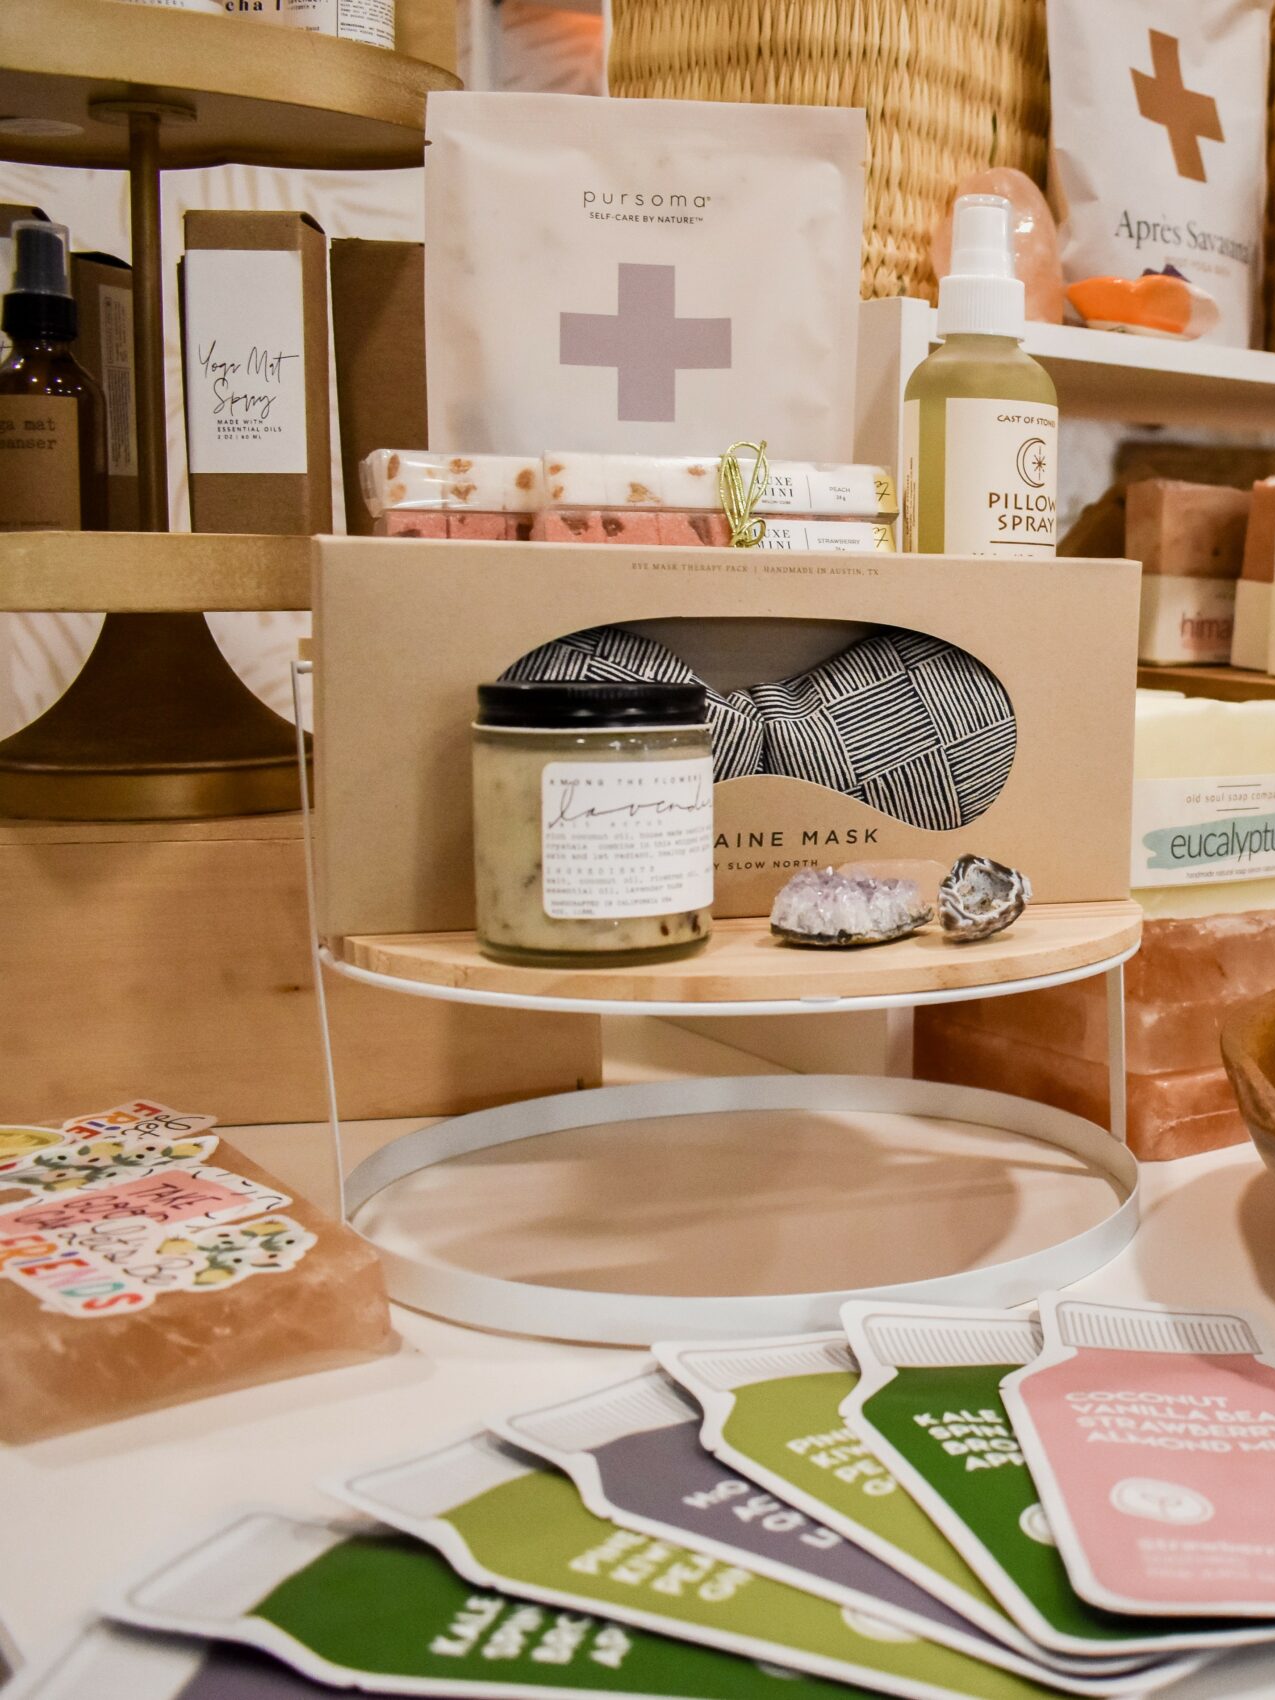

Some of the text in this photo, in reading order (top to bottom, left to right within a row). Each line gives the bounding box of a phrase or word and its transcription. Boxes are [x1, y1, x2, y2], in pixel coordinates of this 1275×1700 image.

[590, 212, 640, 223] SELF-CARE
[643, 215, 654, 223] BY
[1115, 210, 1182, 250] Après
[198, 340, 299, 387] Yoga Mat
[213, 377, 277, 419] Spray
[997, 414, 1021, 422] CAST
[1024, 416, 1034, 424] OF
[998, 514, 1055, 534] SPRAY
[631, 562, 648, 570] EYE
[652, 563, 678, 571] MASK
[682, 564, 722, 572] THERAPY
[726, 565, 748, 573] PACK
[763, 566, 813, 575] HANDMADE
[817, 567, 826, 575] IN
[867, 568, 880, 576] TX
[617, 778, 643, 786] THE
[1186, 793, 1200, 803] old
[1205, 792, 1225, 803] soul
[1228, 792, 1248, 803] soap
[714, 828, 879, 849] AINE MASK
[728, 861, 766, 870] SLOW
[773, 859, 819, 869] NORTH
[1065, 1391, 1228, 1408] COCONUT
[913, 1409, 1004, 1428] KALE
[1071, 1403, 1211, 1421] VANILLA
[928, 1423, 1010, 1440] SPIN
[942, 1437, 1020, 1456] BRO
[1087, 1430, 1233, 1453] ALMOND
